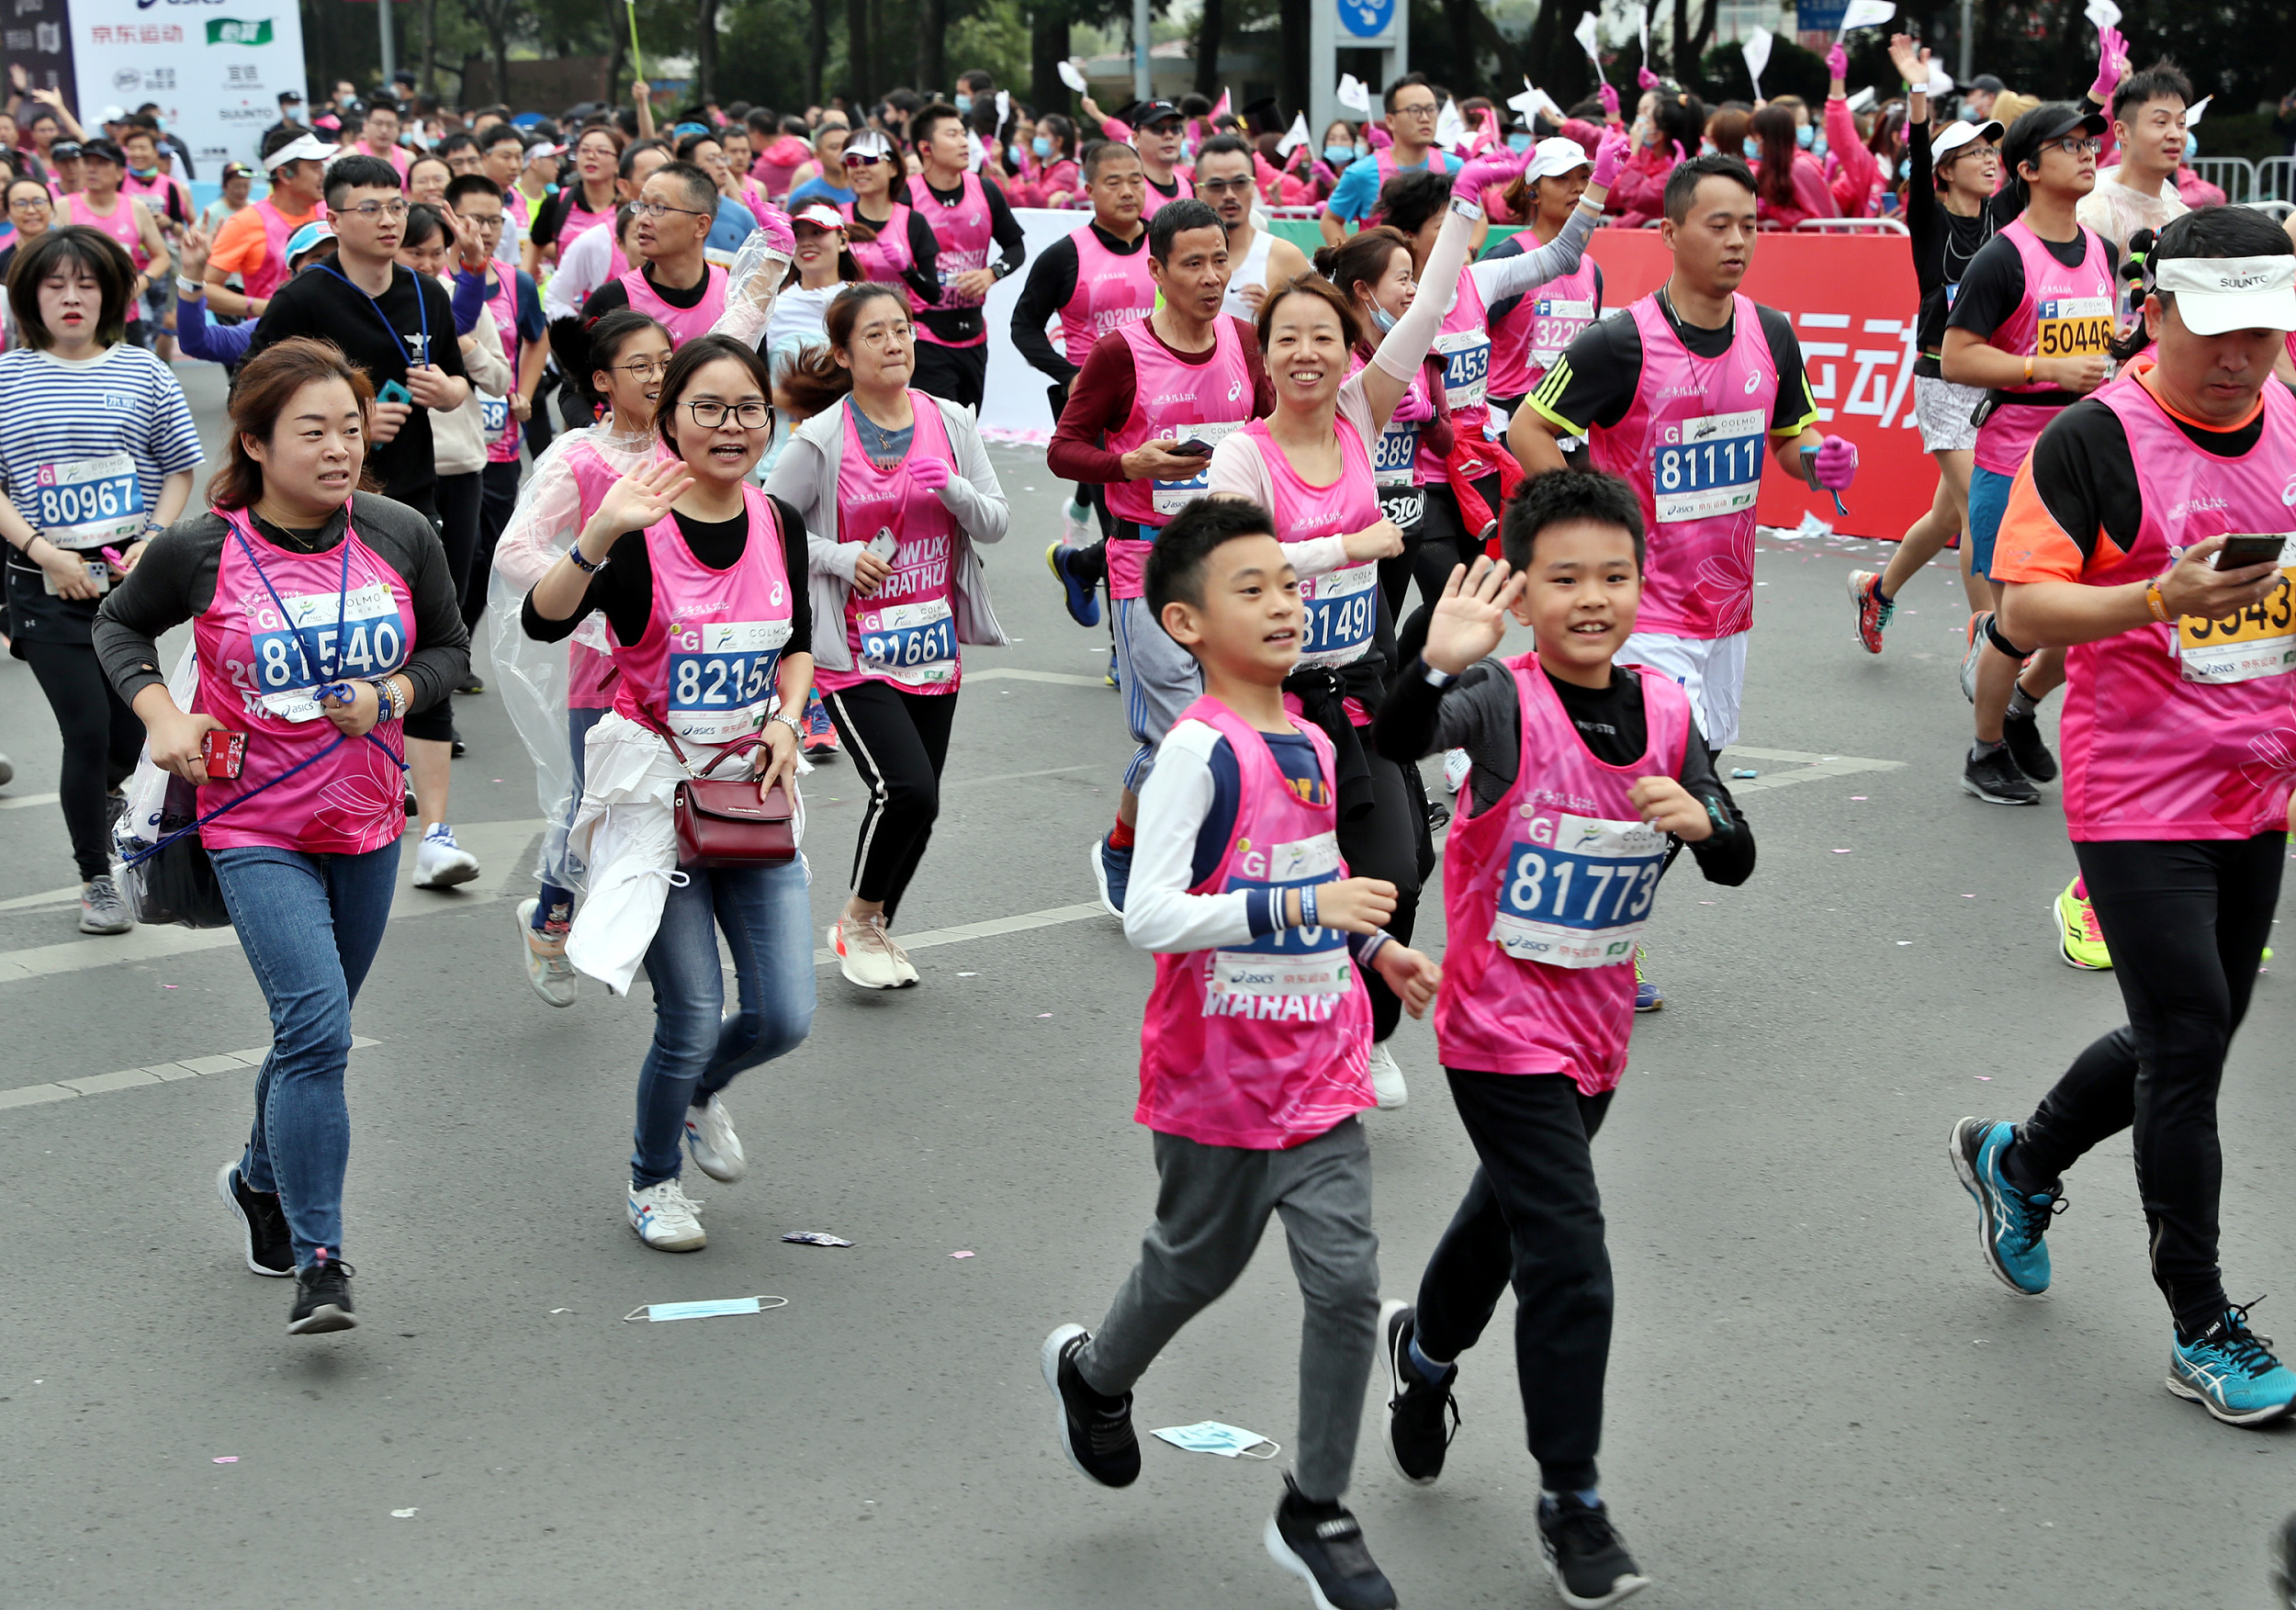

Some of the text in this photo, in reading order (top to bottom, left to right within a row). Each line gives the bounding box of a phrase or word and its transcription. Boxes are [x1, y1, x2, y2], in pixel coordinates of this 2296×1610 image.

[91, 25, 184, 44] 京东运动
[219, 108, 274, 119] SUUNTO
[2219, 275, 2268, 288] SUUNTO
[1540, 303, 1548, 315] F
[2045, 302, 2055, 317] F
[2043, 321, 2110, 355] 50446
[1721, 416, 1756, 428] COLMO
[1664, 426, 1679, 444] G
[1660, 439, 1756, 490] 81111
[40, 469, 53, 485] G
[41, 478, 133, 524] 80967
[1676, 505, 1694, 513] asics
[1299, 580, 1311, 597] G
[336, 592, 381, 610] COLMO
[257, 608, 279, 630] G
[864, 614, 880, 631] G
[681, 631, 700, 651] G
[868, 623, 950, 667] 81661
[263, 622, 400, 688] 81540
[291, 701, 315, 714] asics
[692, 726, 715, 736] asics
[1528, 816, 1553, 844] G
[1242, 850, 1266, 877] G
[1510, 852, 1660, 921] 81773
[1521, 940, 1551, 951] asics
[1244, 973, 1275, 984] asics
[1283, 972, 1330, 984] 京东运动
